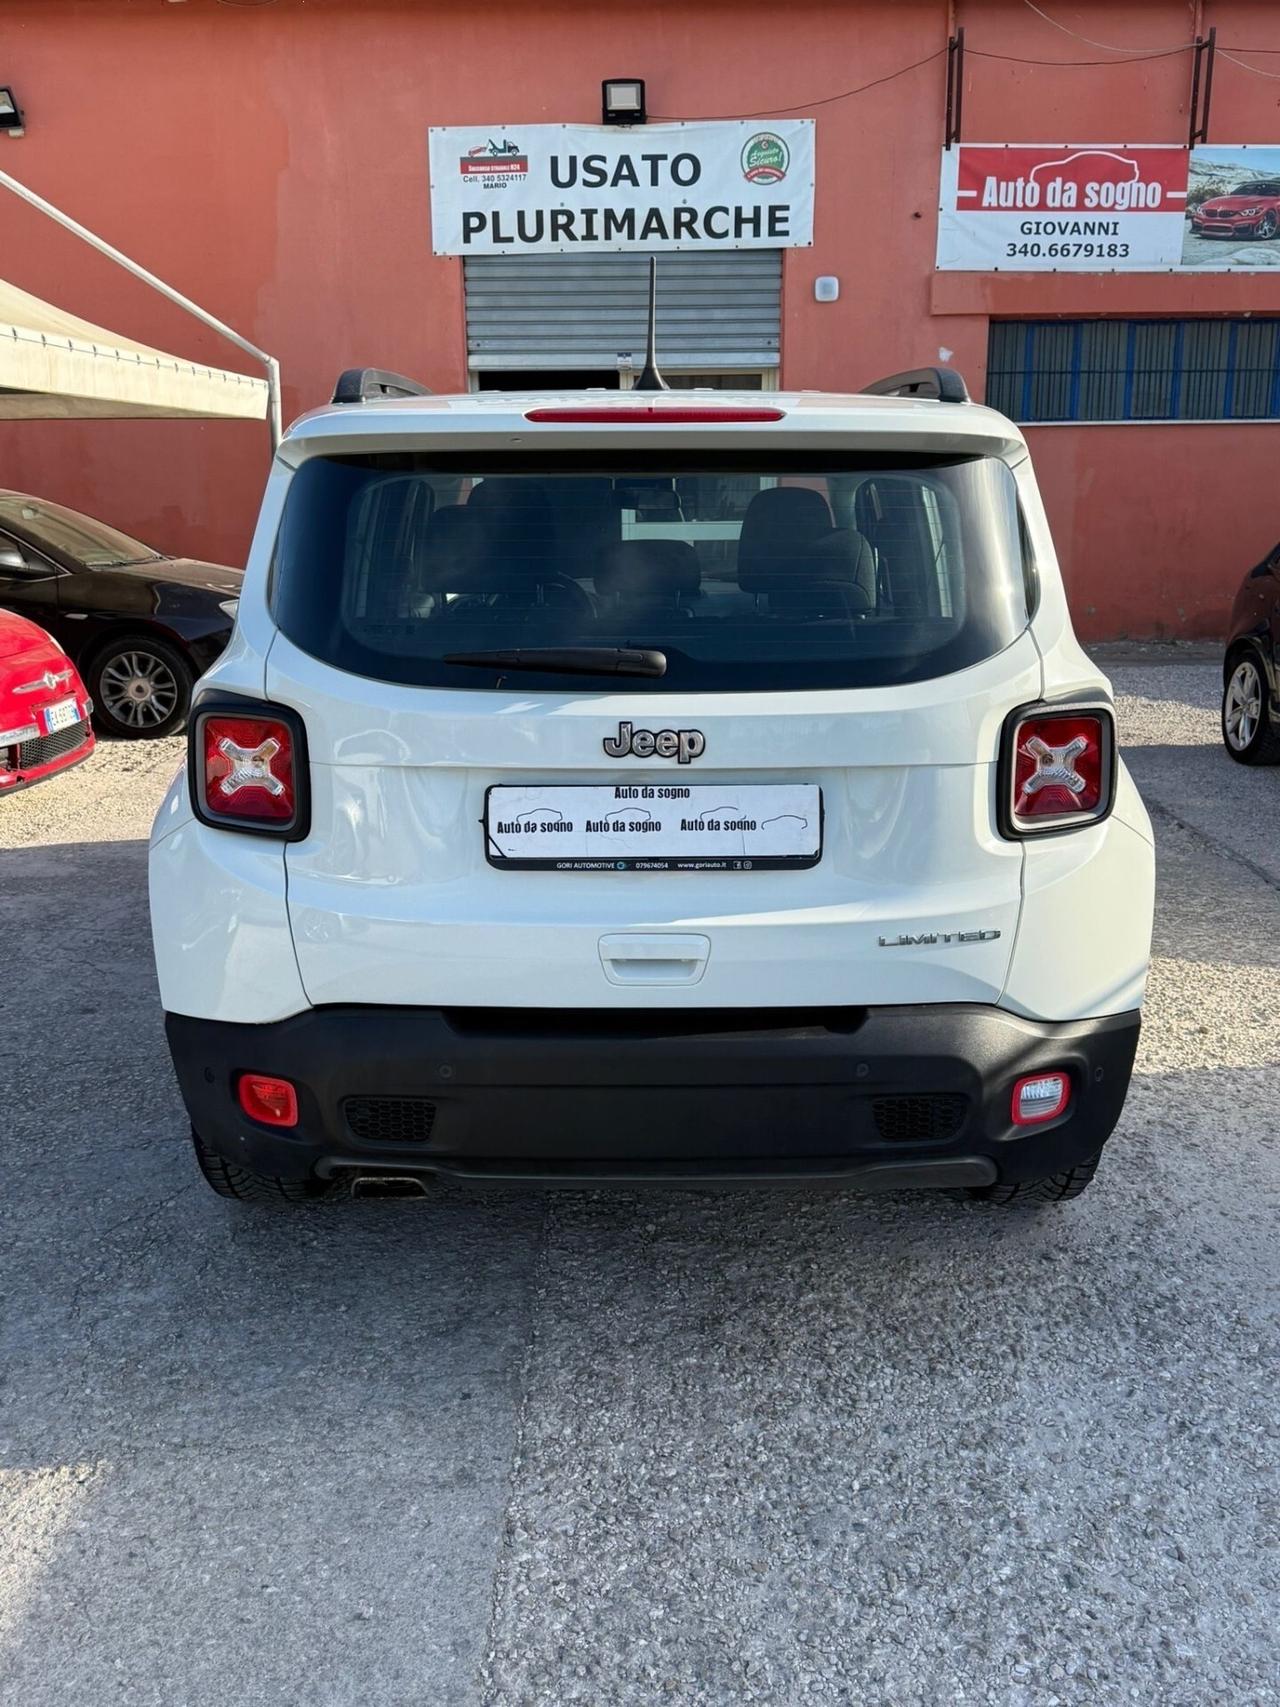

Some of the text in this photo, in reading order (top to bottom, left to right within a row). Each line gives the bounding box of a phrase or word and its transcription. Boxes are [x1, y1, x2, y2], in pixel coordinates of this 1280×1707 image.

[550, 153, 701, 188] USATO
[462, 175, 480, 183] Cell.
[981, 176, 1162, 211] Auto da sogno
[462, 204, 791, 244] PLURIMARCHE
[1020, 221, 1120, 236] GIOVANNI
[1006, 242, 1130, 258] 340.6679183
[603, 721, 706, 764] Jeep
[614, 786, 691, 799] Auto da sogno
[497, 821, 522, 834] Auto
[524, 820, 537, 833] da
[585, 820, 662, 833] Auto da sogno
[680, 819, 705, 831] Auto
[707, 819, 721, 831] da
[677, 862, 727, 870] www.goriauto.it
[878, 930, 1001, 947] LIMITED
